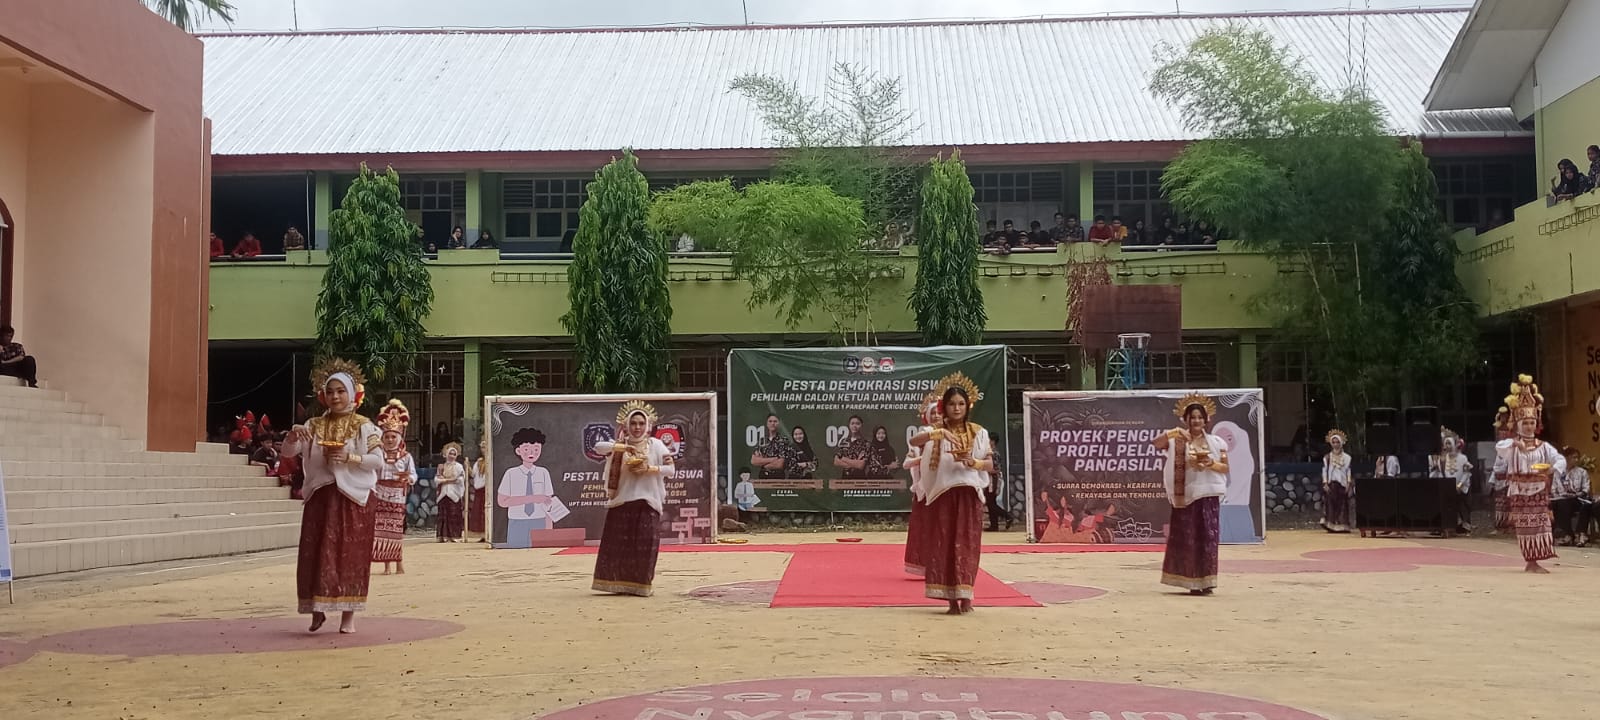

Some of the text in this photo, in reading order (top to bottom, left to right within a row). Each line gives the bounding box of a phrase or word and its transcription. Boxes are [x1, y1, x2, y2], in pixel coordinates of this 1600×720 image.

[783, 380, 940, 391] PESTA DEMOKRASI SISW
[750, 393, 923, 402] PEMILIHAN CALON KETUA DAN WAKIL
[746, 425, 765, 447] 01
[826, 425, 850, 447] 02
[1040, 430, 1104, 443] PROYEK
[1057, 444, 1112, 457] PROFIL
[1074, 458, 1163, 471] PANCASILA
[563, 472, 599, 481] PESTA
[645, 688, 979, 702] Selalu
